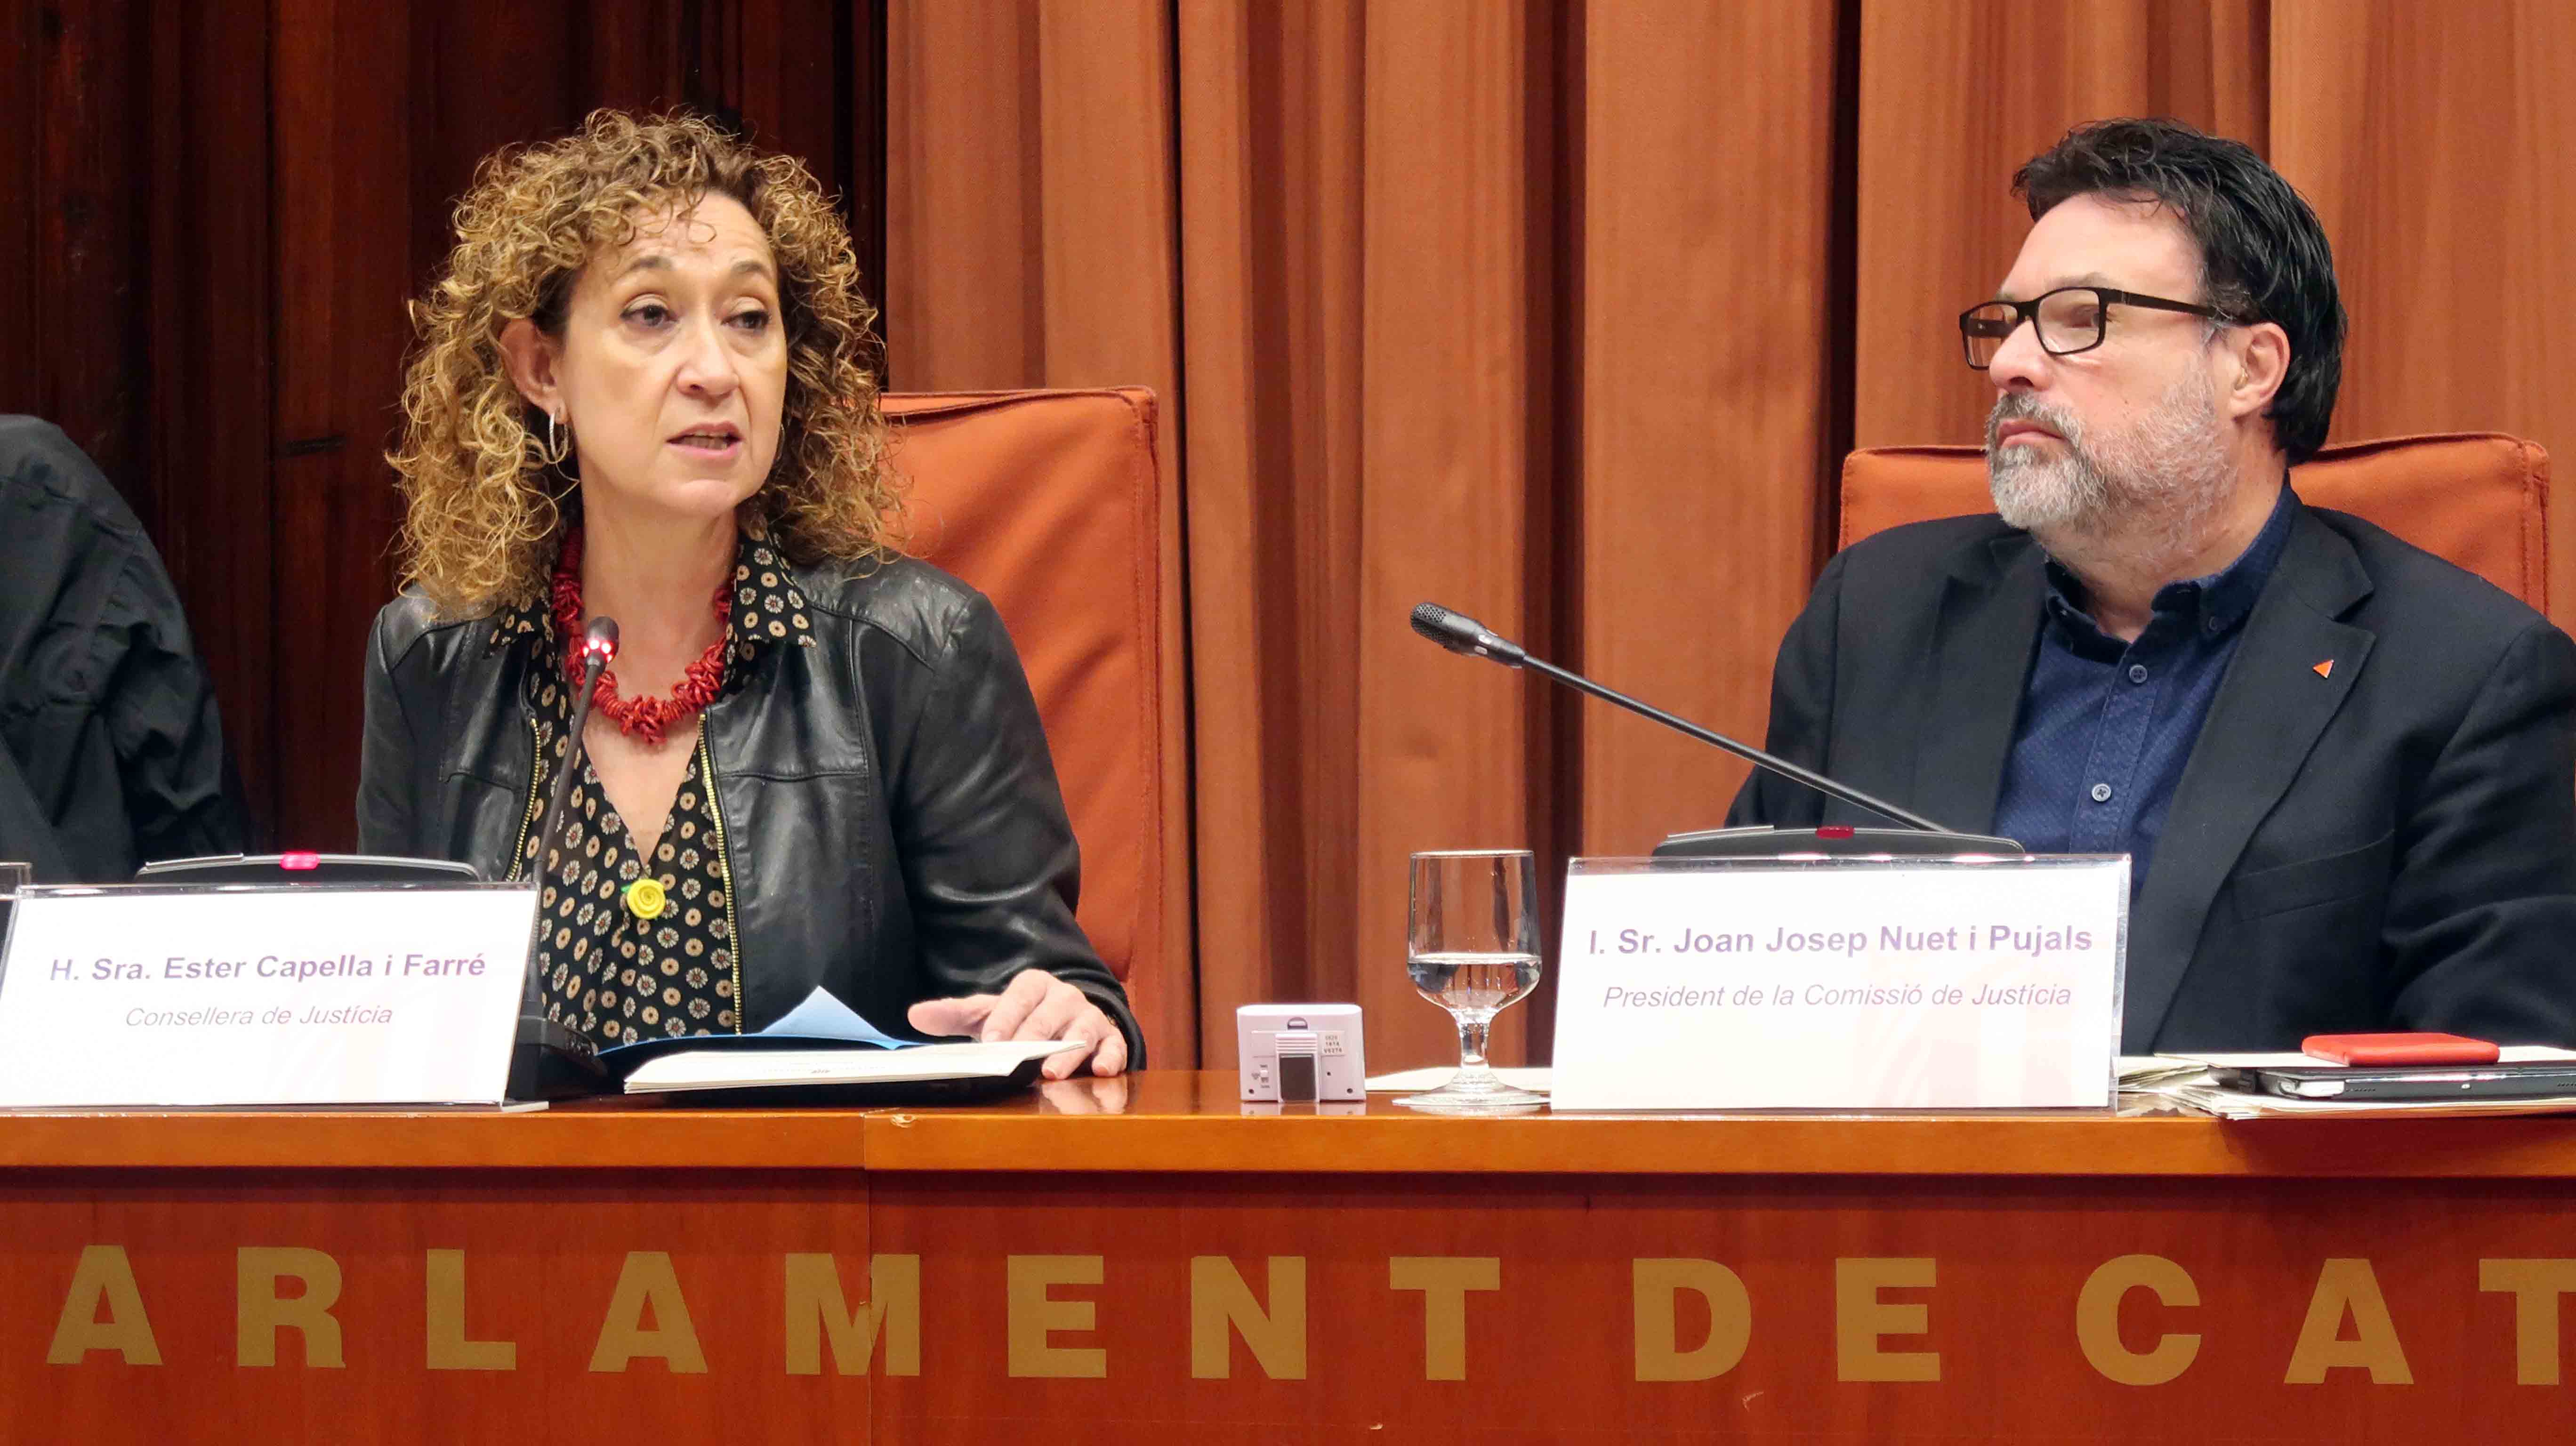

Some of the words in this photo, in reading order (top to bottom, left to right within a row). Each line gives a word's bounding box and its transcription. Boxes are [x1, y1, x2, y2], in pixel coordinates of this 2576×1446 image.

[1590, 930, 1605, 955] I.
[1618, 929, 1661, 954] Sr.
[1673, 927, 1754, 953] Joan
[1766, 927, 1868, 957] Josep
[1880, 926, 1958, 951] Nuet
[1969, 925, 1976, 951] i
[1989, 925, 2092, 957] Pujals
[50, 959, 79, 980] H.
[92, 958, 150, 980] Sra.
[164, 957, 247, 979] Ester
[257, 954, 373, 983] Capella
[385, 954, 393, 976] i
[403, 952, 485, 976] Farré
[1603, 986, 1725, 1007] President
[1732, 985, 1763, 1006] de
[1773, 985, 1794, 1006] la
[1804, 984, 1923, 1005] Comissió
[1932, 984, 1963, 1005] de
[1972, 984, 2071, 1005] Justícia
[126, 1007, 254, 1026] Consellera
[262, 1006, 291, 1025] de
[299, 1005, 392, 1024] Justícia
[48, 1245, 1500, 1380] ARLAMENT
[1633, 1257, 1940, 1382] DE
[2077, 1254, 2576, 1385] CAT
